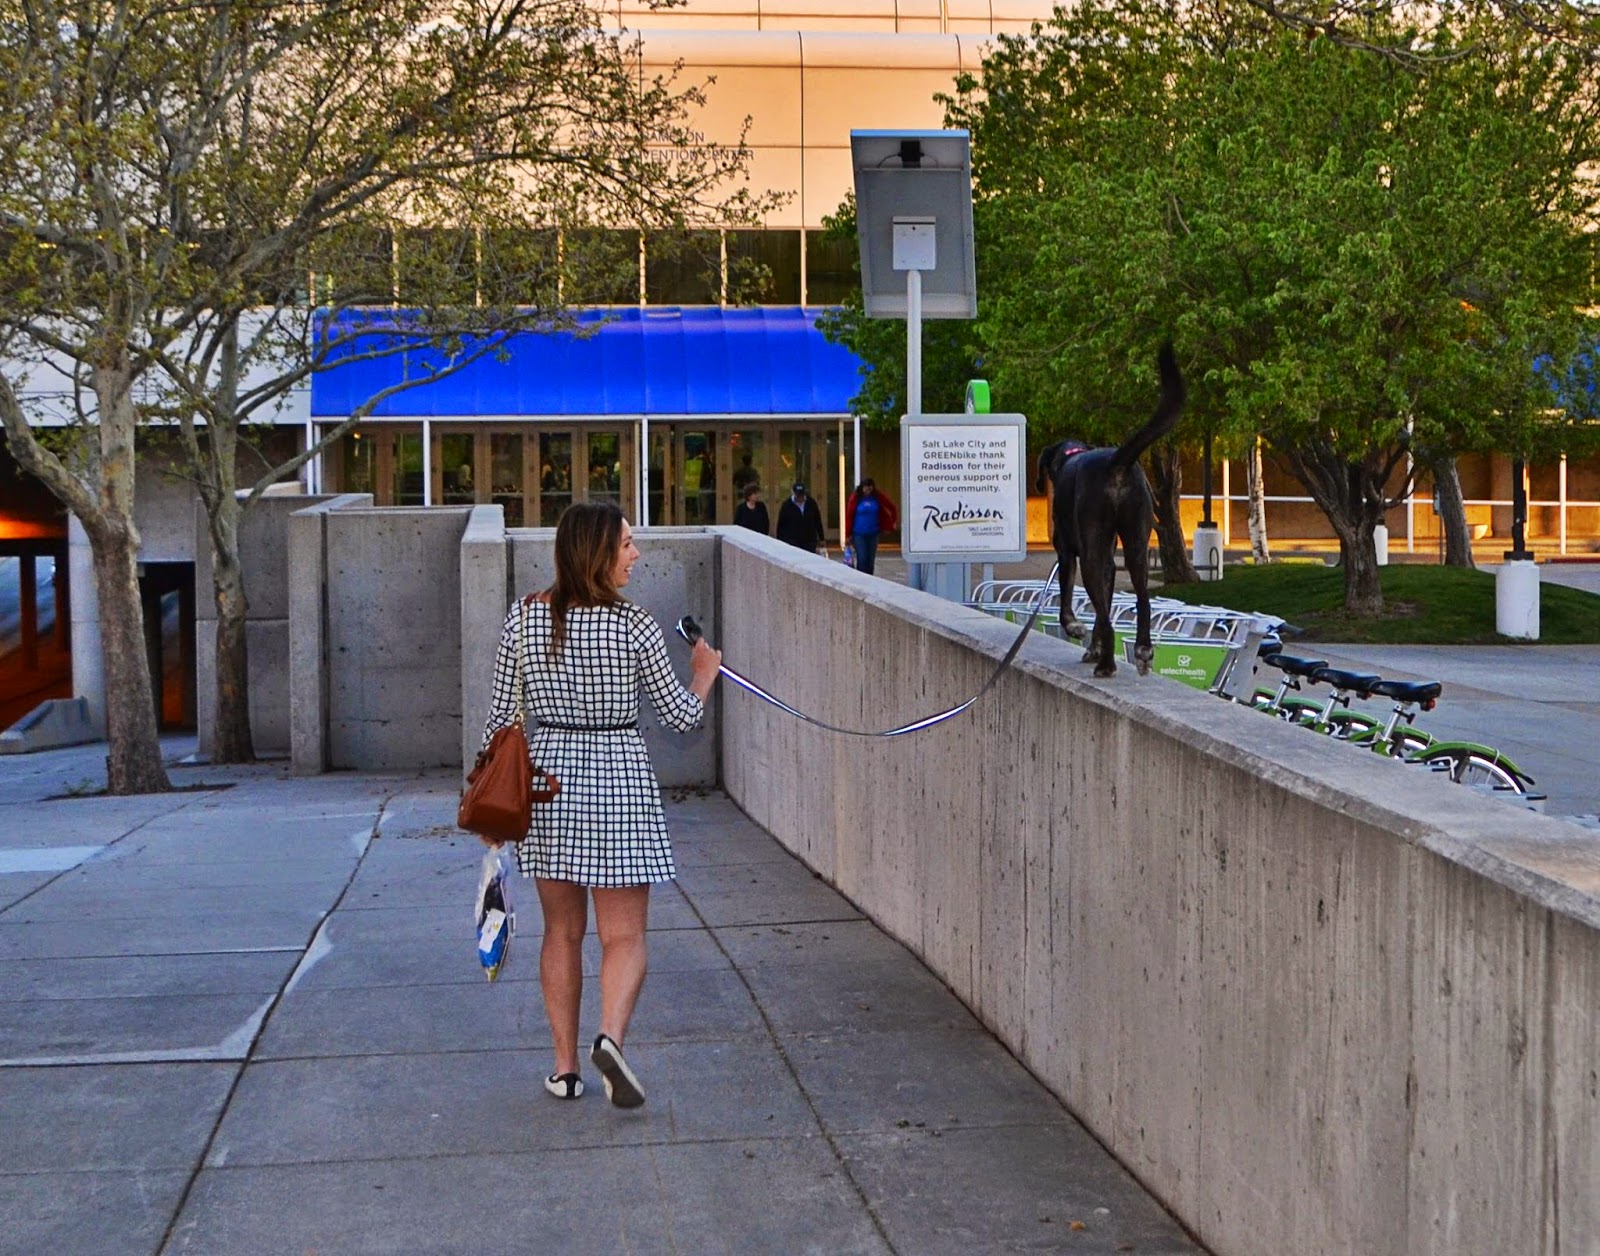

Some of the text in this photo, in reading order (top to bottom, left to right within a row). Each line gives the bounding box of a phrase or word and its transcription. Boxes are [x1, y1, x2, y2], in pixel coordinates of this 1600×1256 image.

[641, 130, 705, 142] RAMON
[922, 440, 1006, 449] Salt Lake City and
[923, 451, 1005, 459] GREENbike thank
[921, 462, 1005, 470] Radisson for their
[917, 473, 1012, 483] generous support of
[928, 485, 1001, 493] our community.
[923, 501, 1004, 532] Radisson
